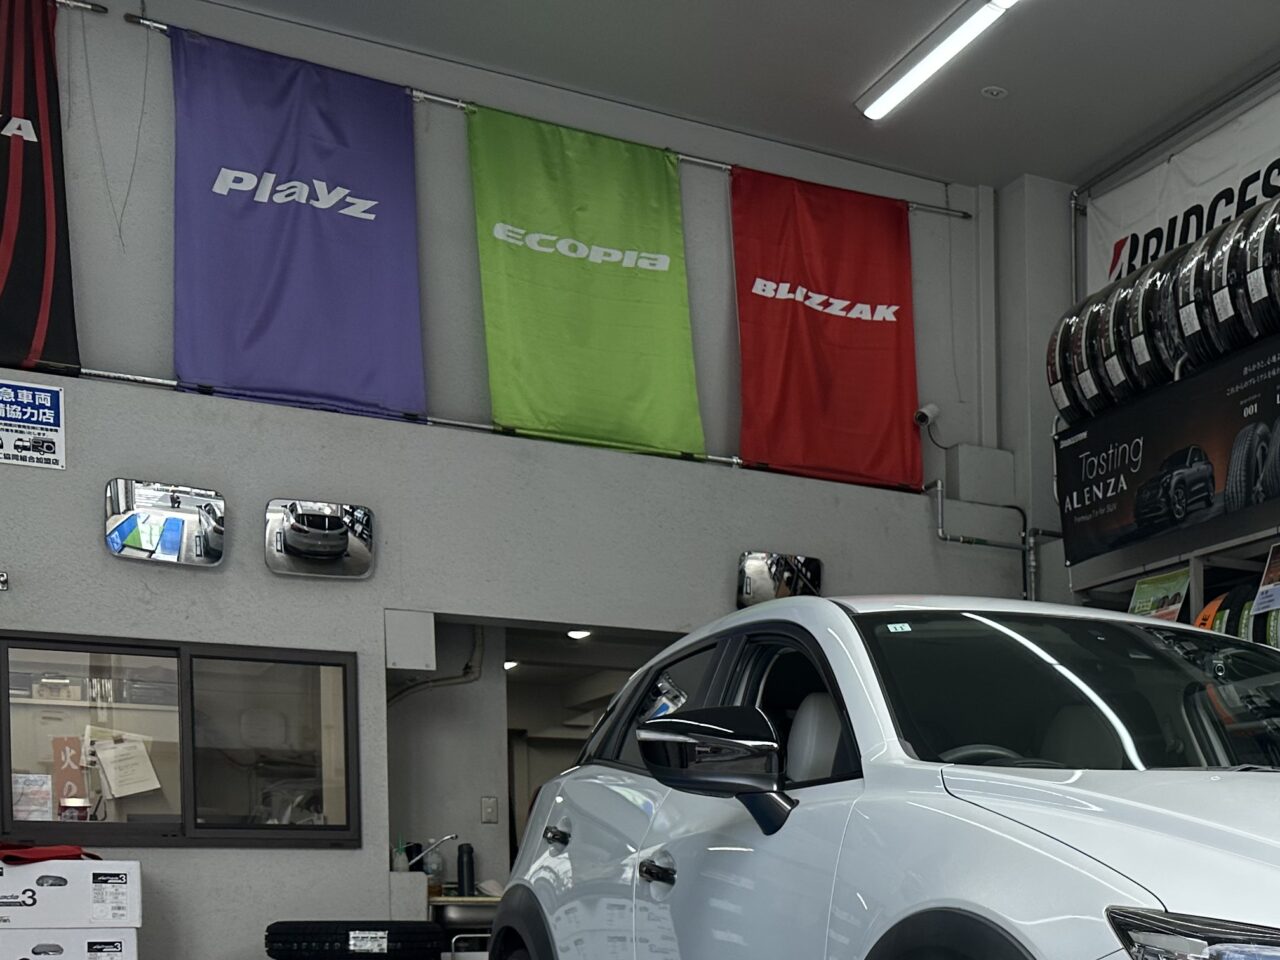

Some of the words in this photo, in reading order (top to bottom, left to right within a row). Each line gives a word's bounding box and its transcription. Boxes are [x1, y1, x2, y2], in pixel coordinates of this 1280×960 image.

[212, 167, 379, 221] Playz
[492, 222, 671, 273] ECOPIA
[751, 277, 900, 323] BLIZZAK
[1078, 435, 1145, 482] Tasting
[1064, 474, 1128, 513] ALENZA
